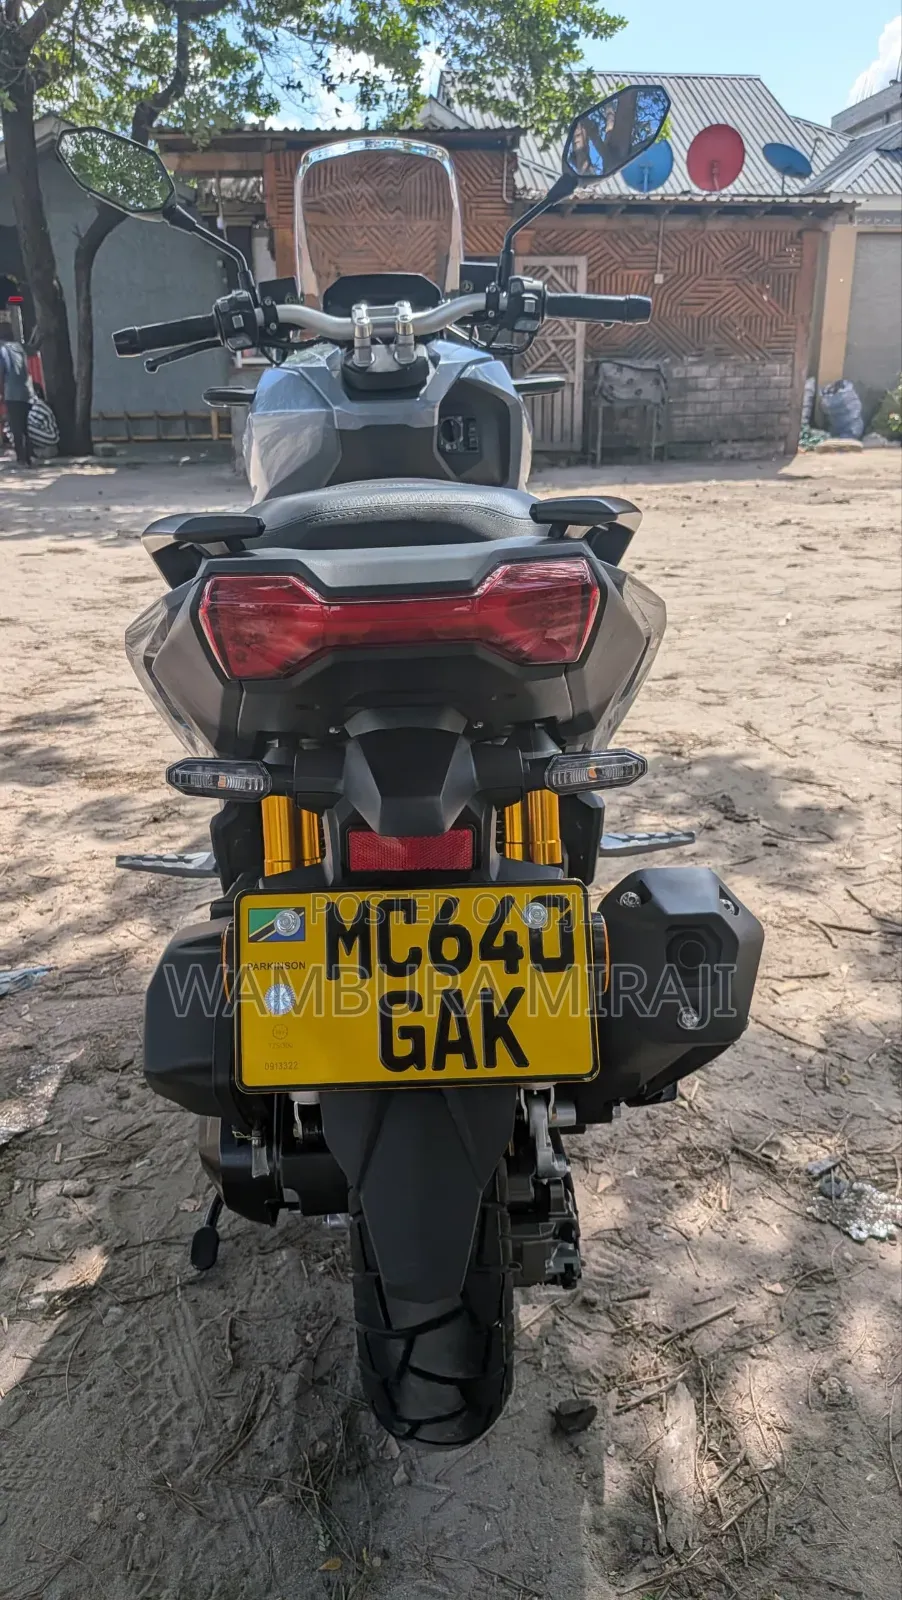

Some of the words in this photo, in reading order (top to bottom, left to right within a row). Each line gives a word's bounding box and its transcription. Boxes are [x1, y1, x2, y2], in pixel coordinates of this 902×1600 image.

[246, 961, 306, 971] PARKINSON
[325, 894, 575, 981] MC640
[377, 986, 530, 1072] GAK
